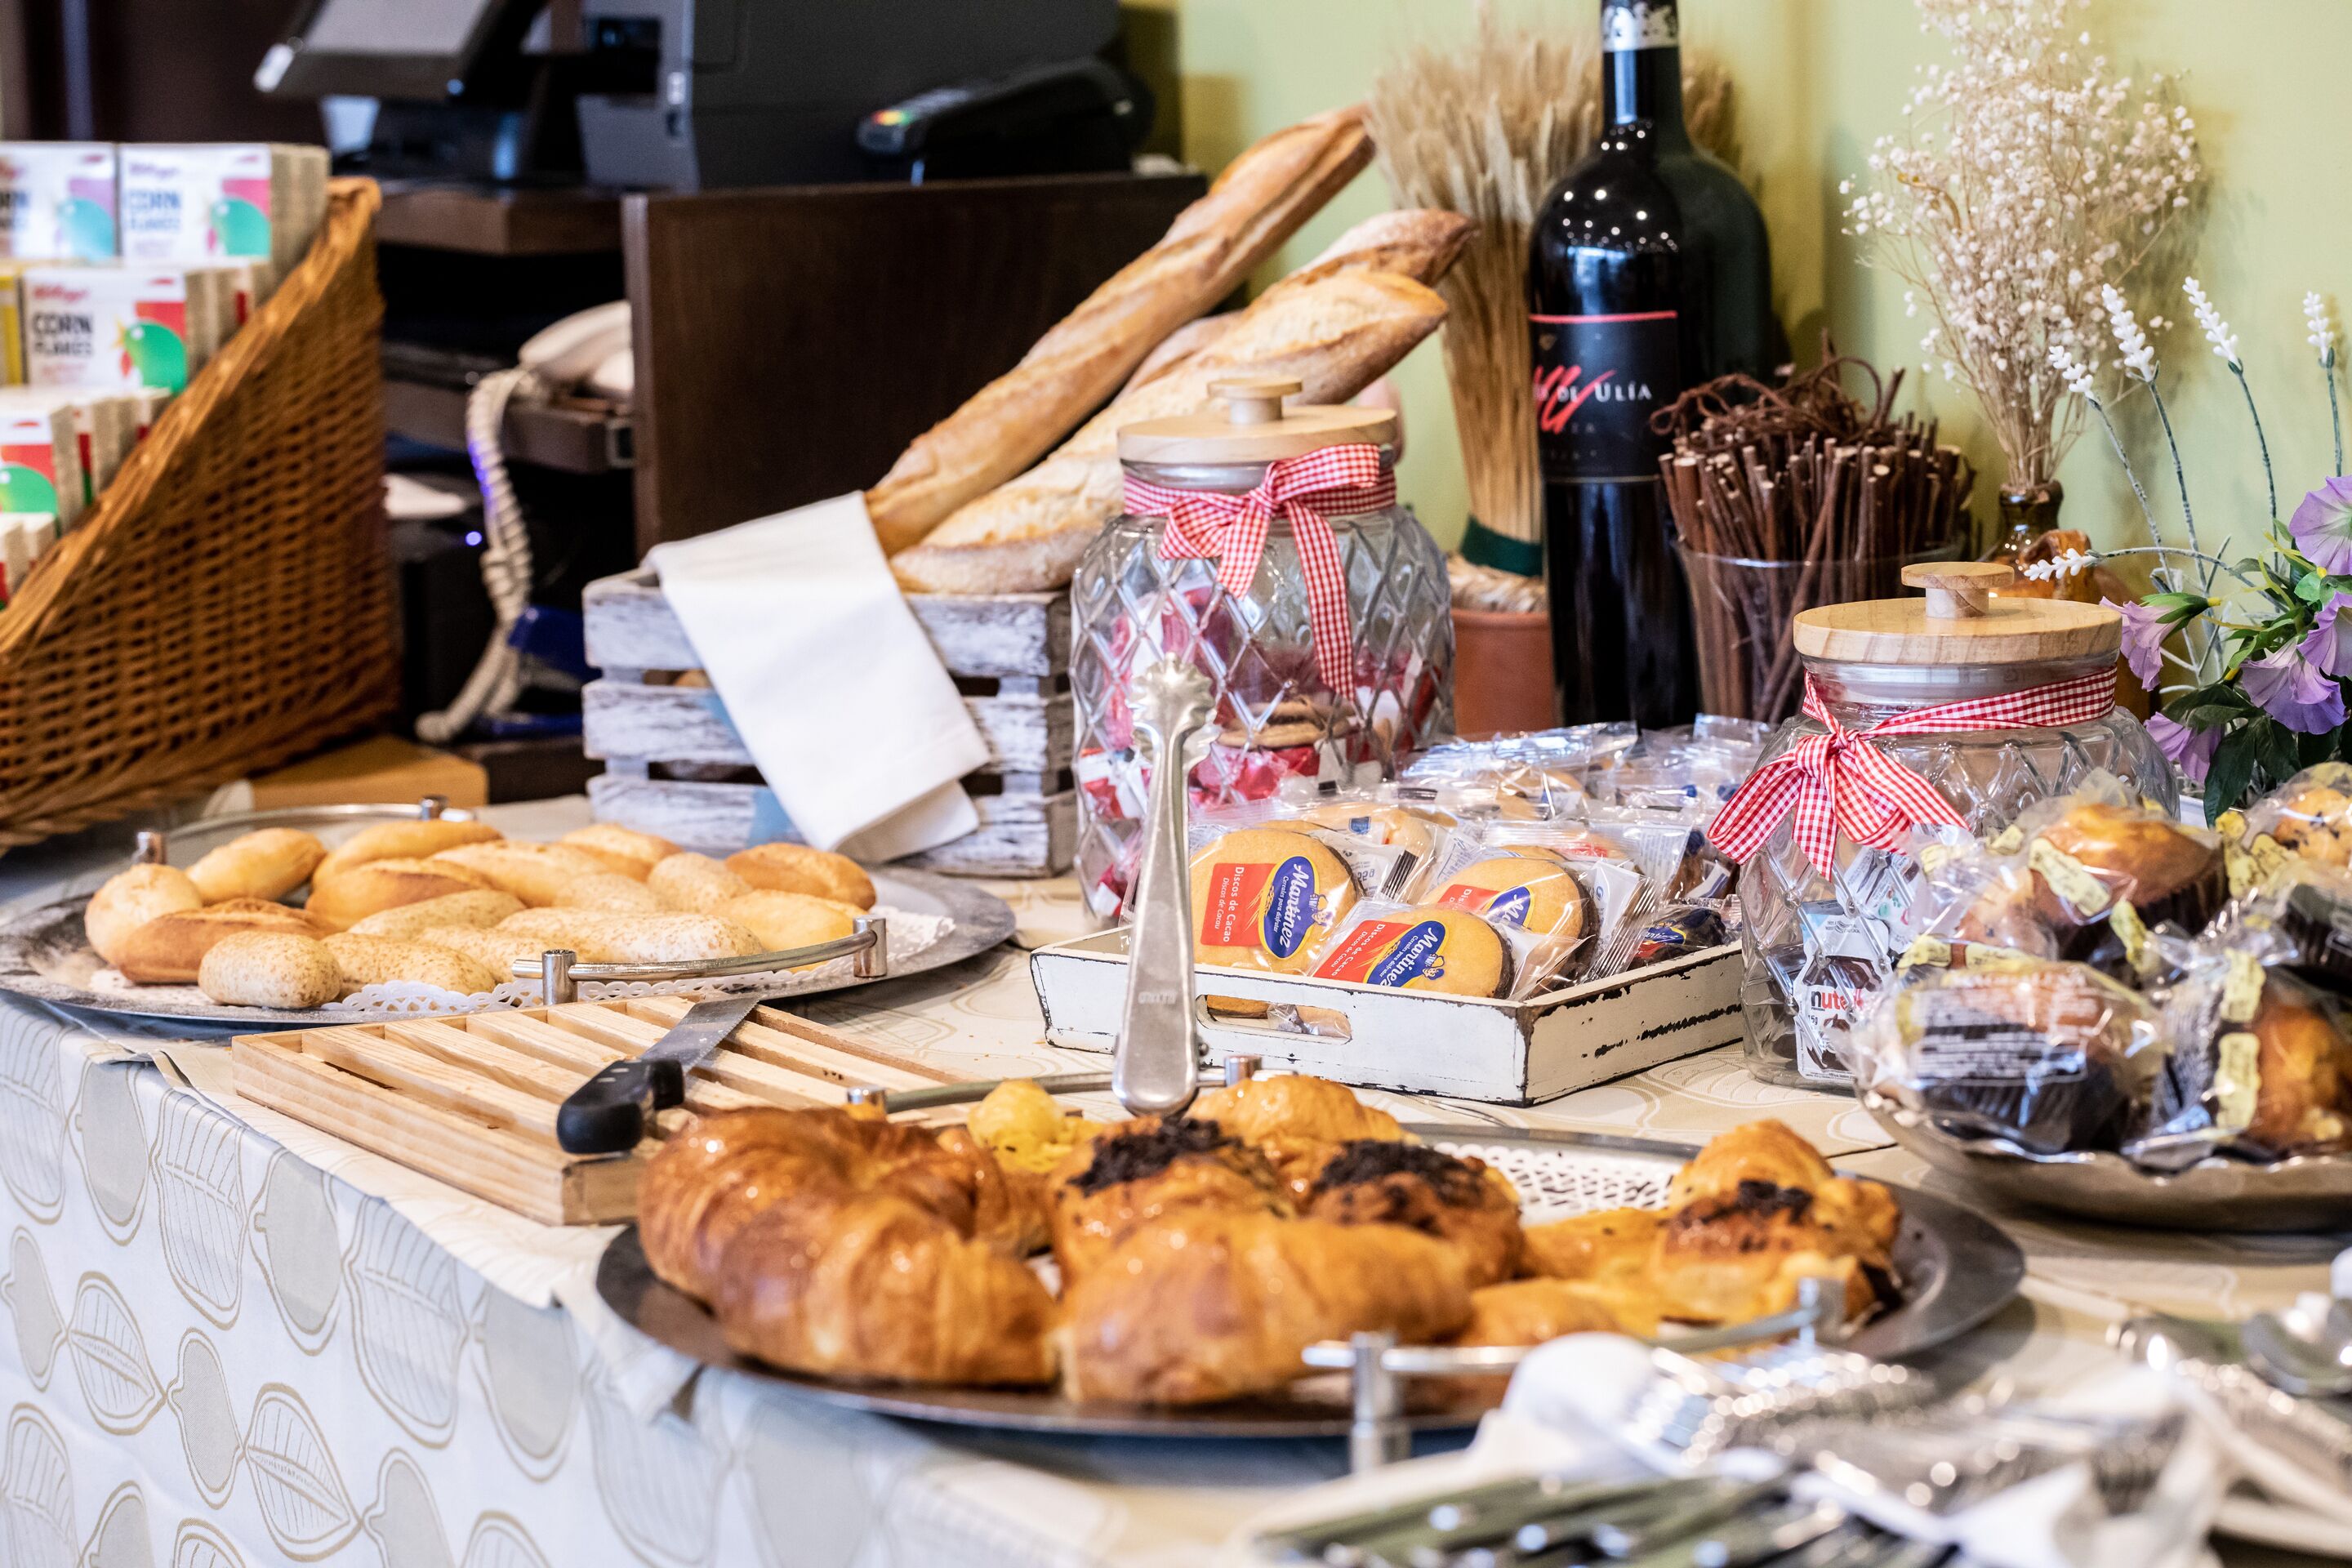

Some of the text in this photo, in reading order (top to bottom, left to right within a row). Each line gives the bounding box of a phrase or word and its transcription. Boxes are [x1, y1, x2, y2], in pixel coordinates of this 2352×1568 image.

[32, 312, 93, 336] CORN
[1214, 877, 1230, 929] Discos de Cacau
[1223, 866, 1245, 942] Discos de Cacao
[1280, 863, 1310, 949] Martínez
[1351, 931, 1368, 947] Discos
[1361, 924, 1386, 946] Discos
[1352, 947, 1363, 956] de
[1331, 956, 1354, 976] Cacao
